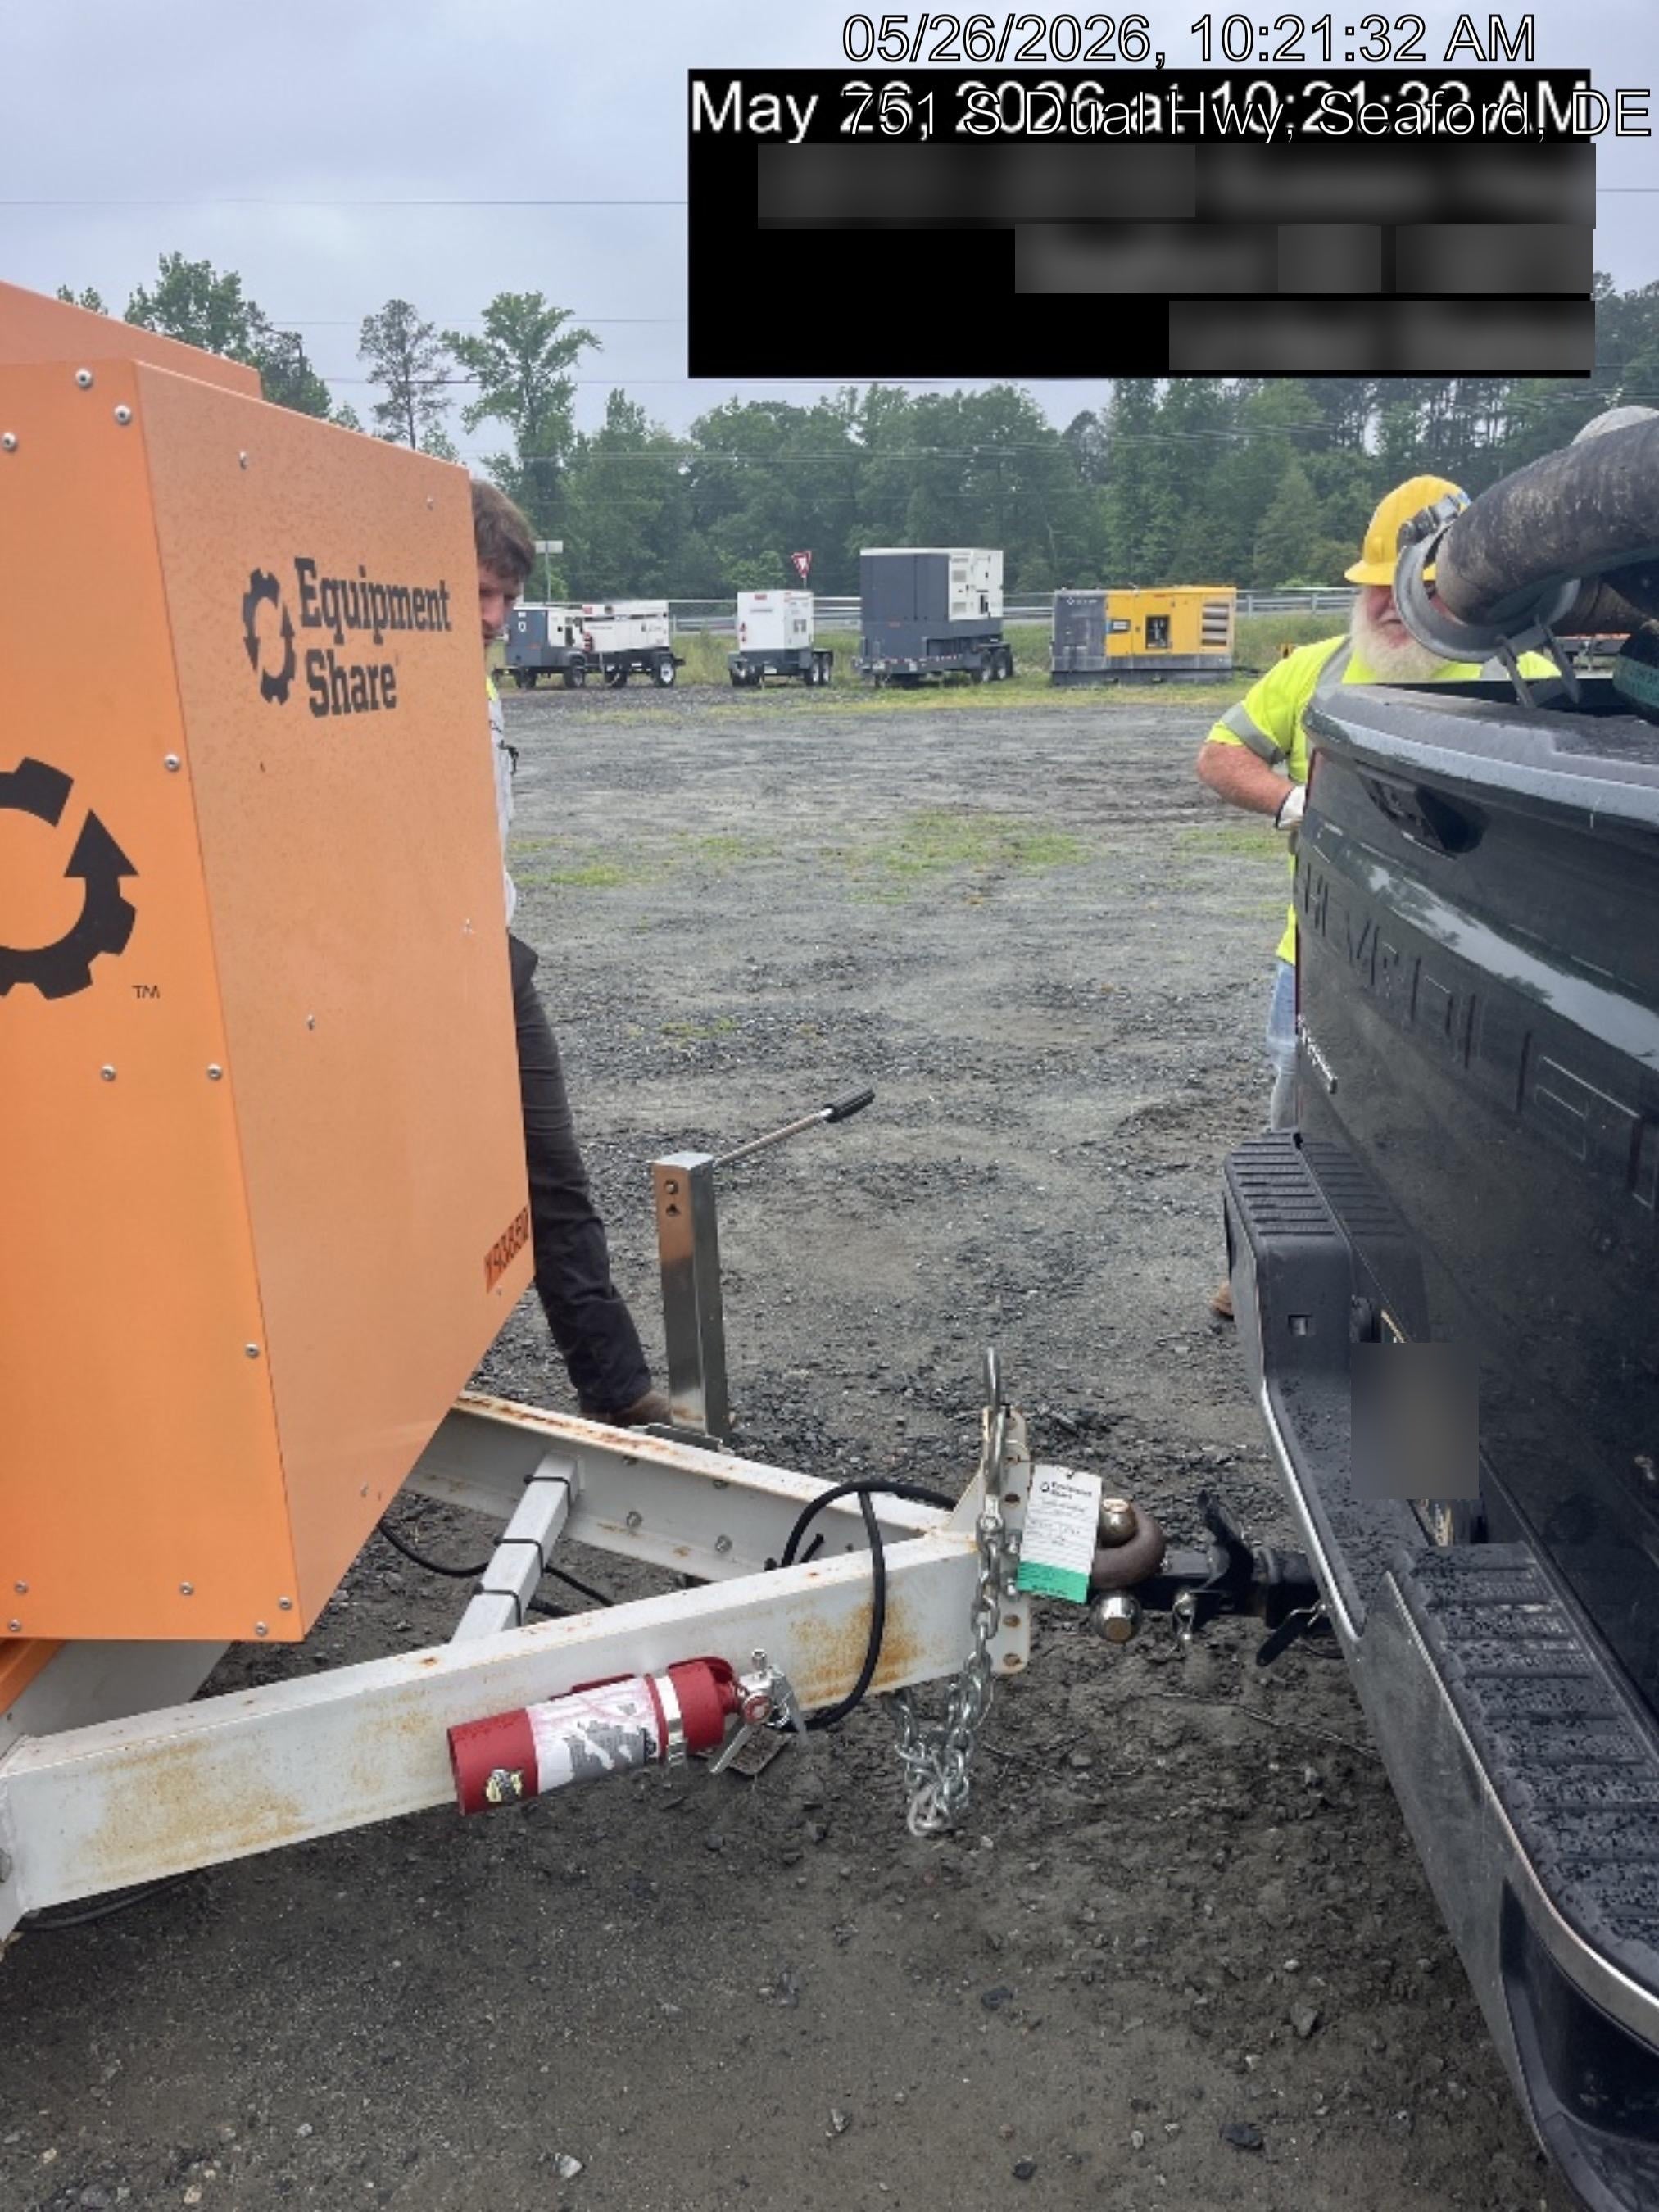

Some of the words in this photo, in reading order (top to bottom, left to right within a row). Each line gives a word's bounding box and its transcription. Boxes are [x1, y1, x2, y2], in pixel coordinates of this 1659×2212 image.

[293, 557, 452, 646] Equipment
[306, 649, 397, 718] Share
[131, 985, 161, 999] TM
